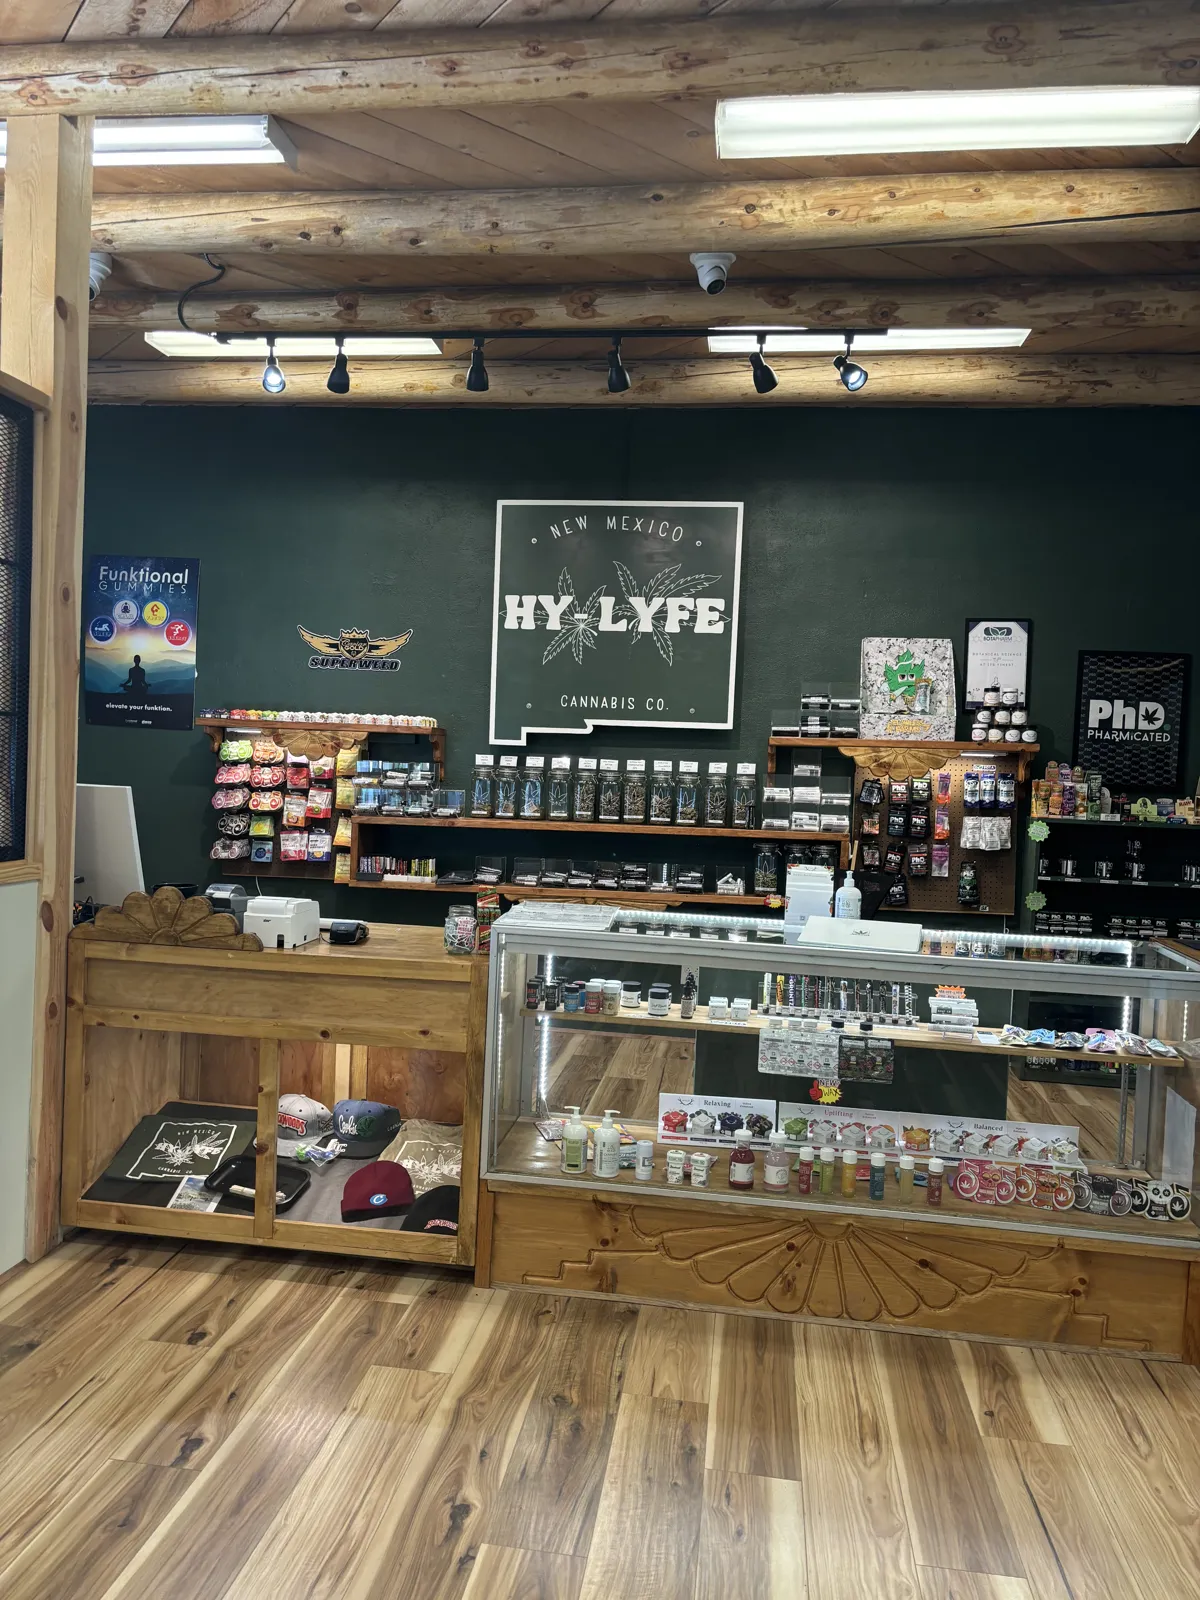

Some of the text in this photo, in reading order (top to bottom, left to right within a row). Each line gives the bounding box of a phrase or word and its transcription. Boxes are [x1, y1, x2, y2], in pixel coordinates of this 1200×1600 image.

[550, 515, 684, 542] NEW MEXICO
[99, 566, 188, 584] Funktional
[98, 581, 187, 594] GUMMIES
[504, 594, 725, 634] HY-LYFE
[309, 656, 400, 671] SUPERWEED
[144, 704, 173, 712] funktion.
[561, 695, 669, 711] CANNABIS CO.
[822, 1088, 840, 1097] WAX
[704, 1100, 731, 1108] Relaxing
[824, 1109, 853, 1118] Uplifting
[974, 1123, 1003, 1131] Balanced
